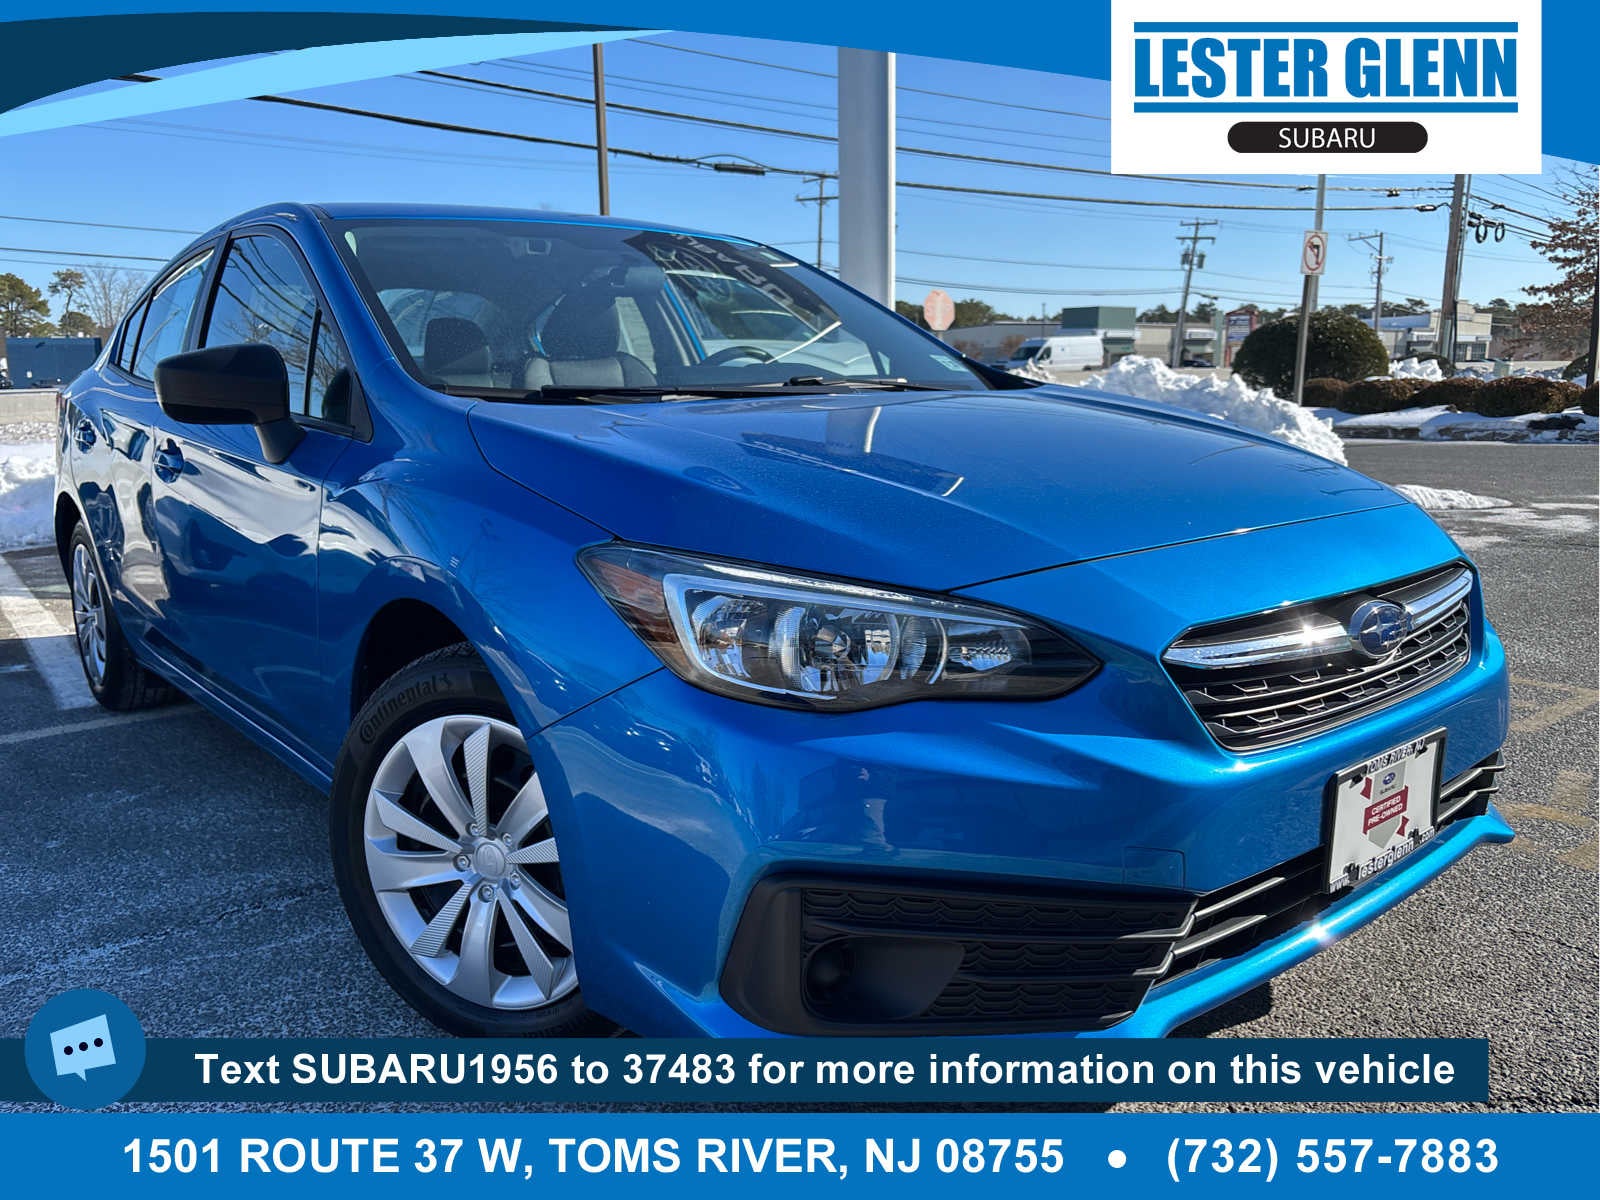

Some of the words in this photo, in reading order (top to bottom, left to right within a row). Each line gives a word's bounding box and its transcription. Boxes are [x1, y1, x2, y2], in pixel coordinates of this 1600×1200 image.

[360, 675, 438, 744] Continental
[1366, 753, 1391, 775] TOMS
[1390, 743, 1415, 765] RIVER
[1367, 803, 1403, 827] PRE-OWNED
[1371, 795, 1402, 815] CERTIFIED
